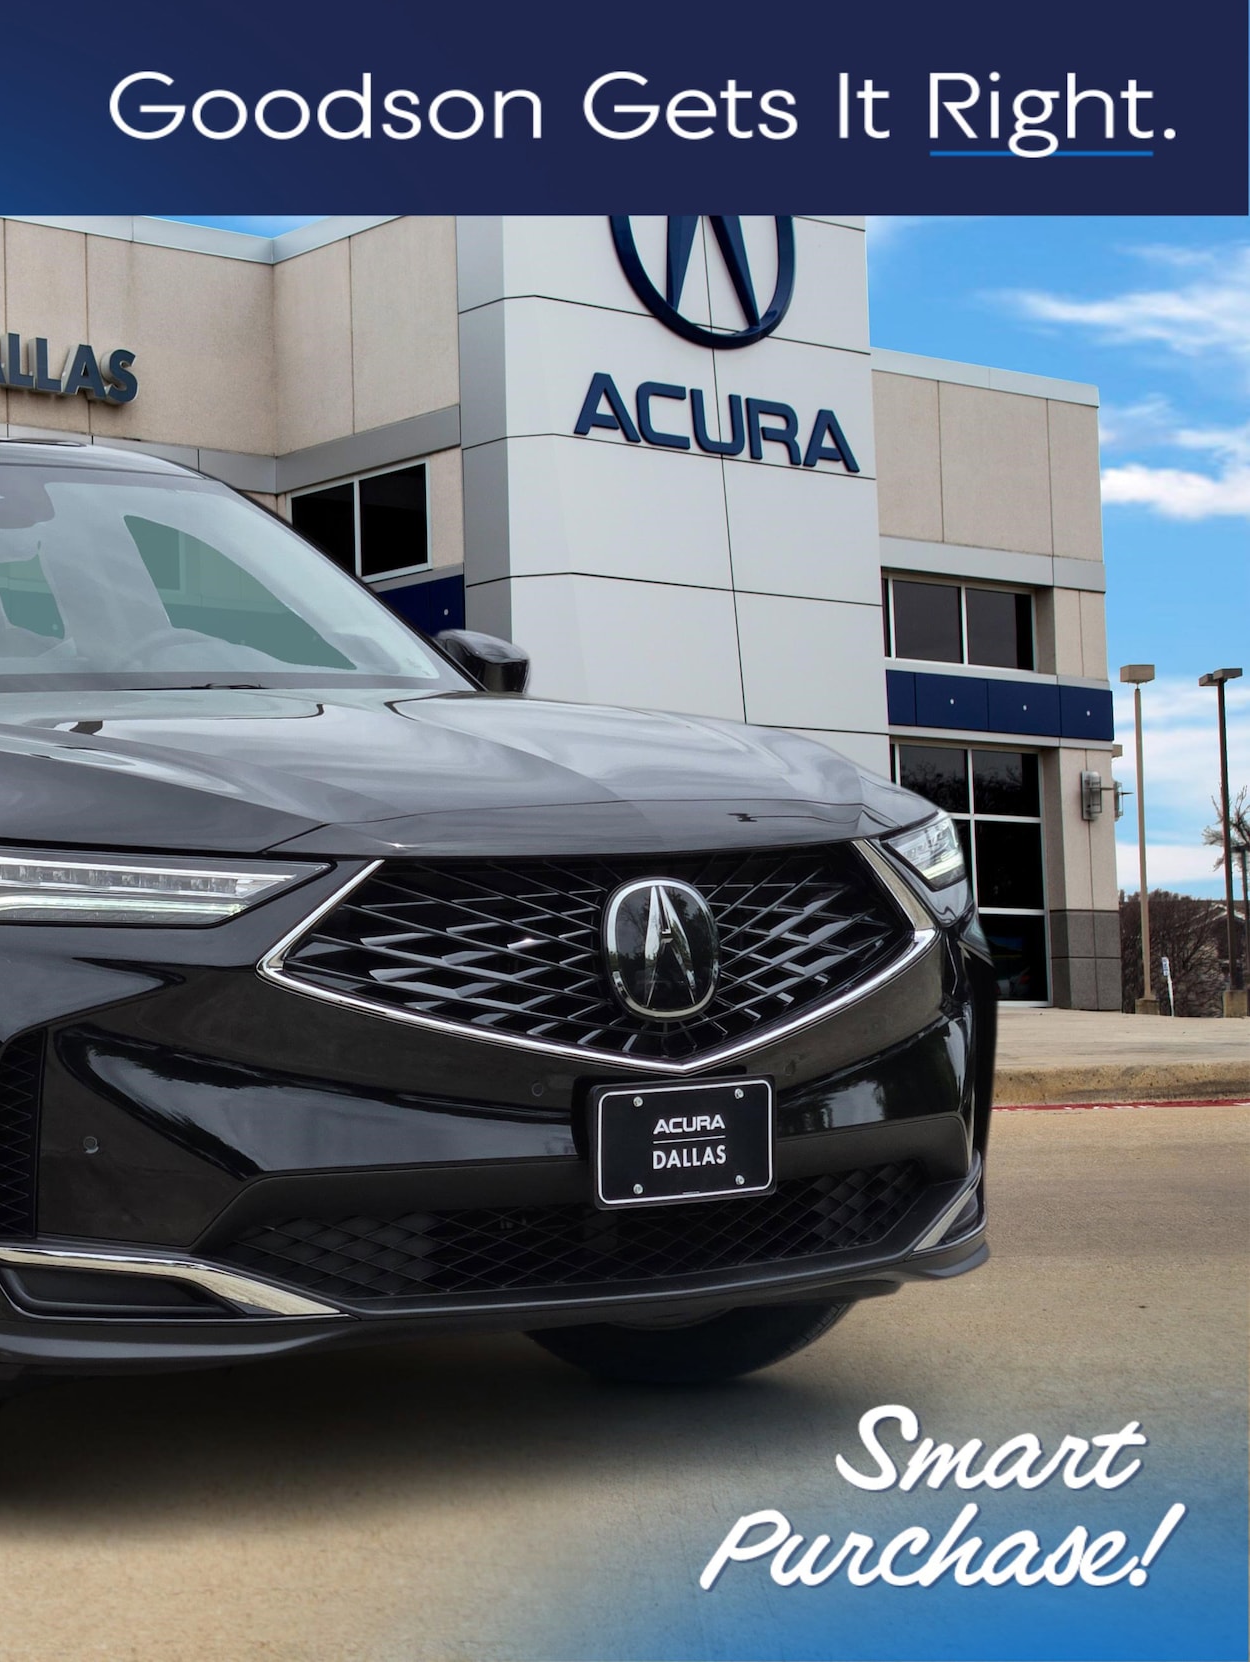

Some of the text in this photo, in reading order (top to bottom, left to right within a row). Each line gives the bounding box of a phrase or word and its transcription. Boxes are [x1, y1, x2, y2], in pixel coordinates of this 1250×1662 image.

[573, 372, 861, 473] ACURA
[653, 1113, 726, 1136] ACURA
[652, 1144, 727, 1170] DALLAS
